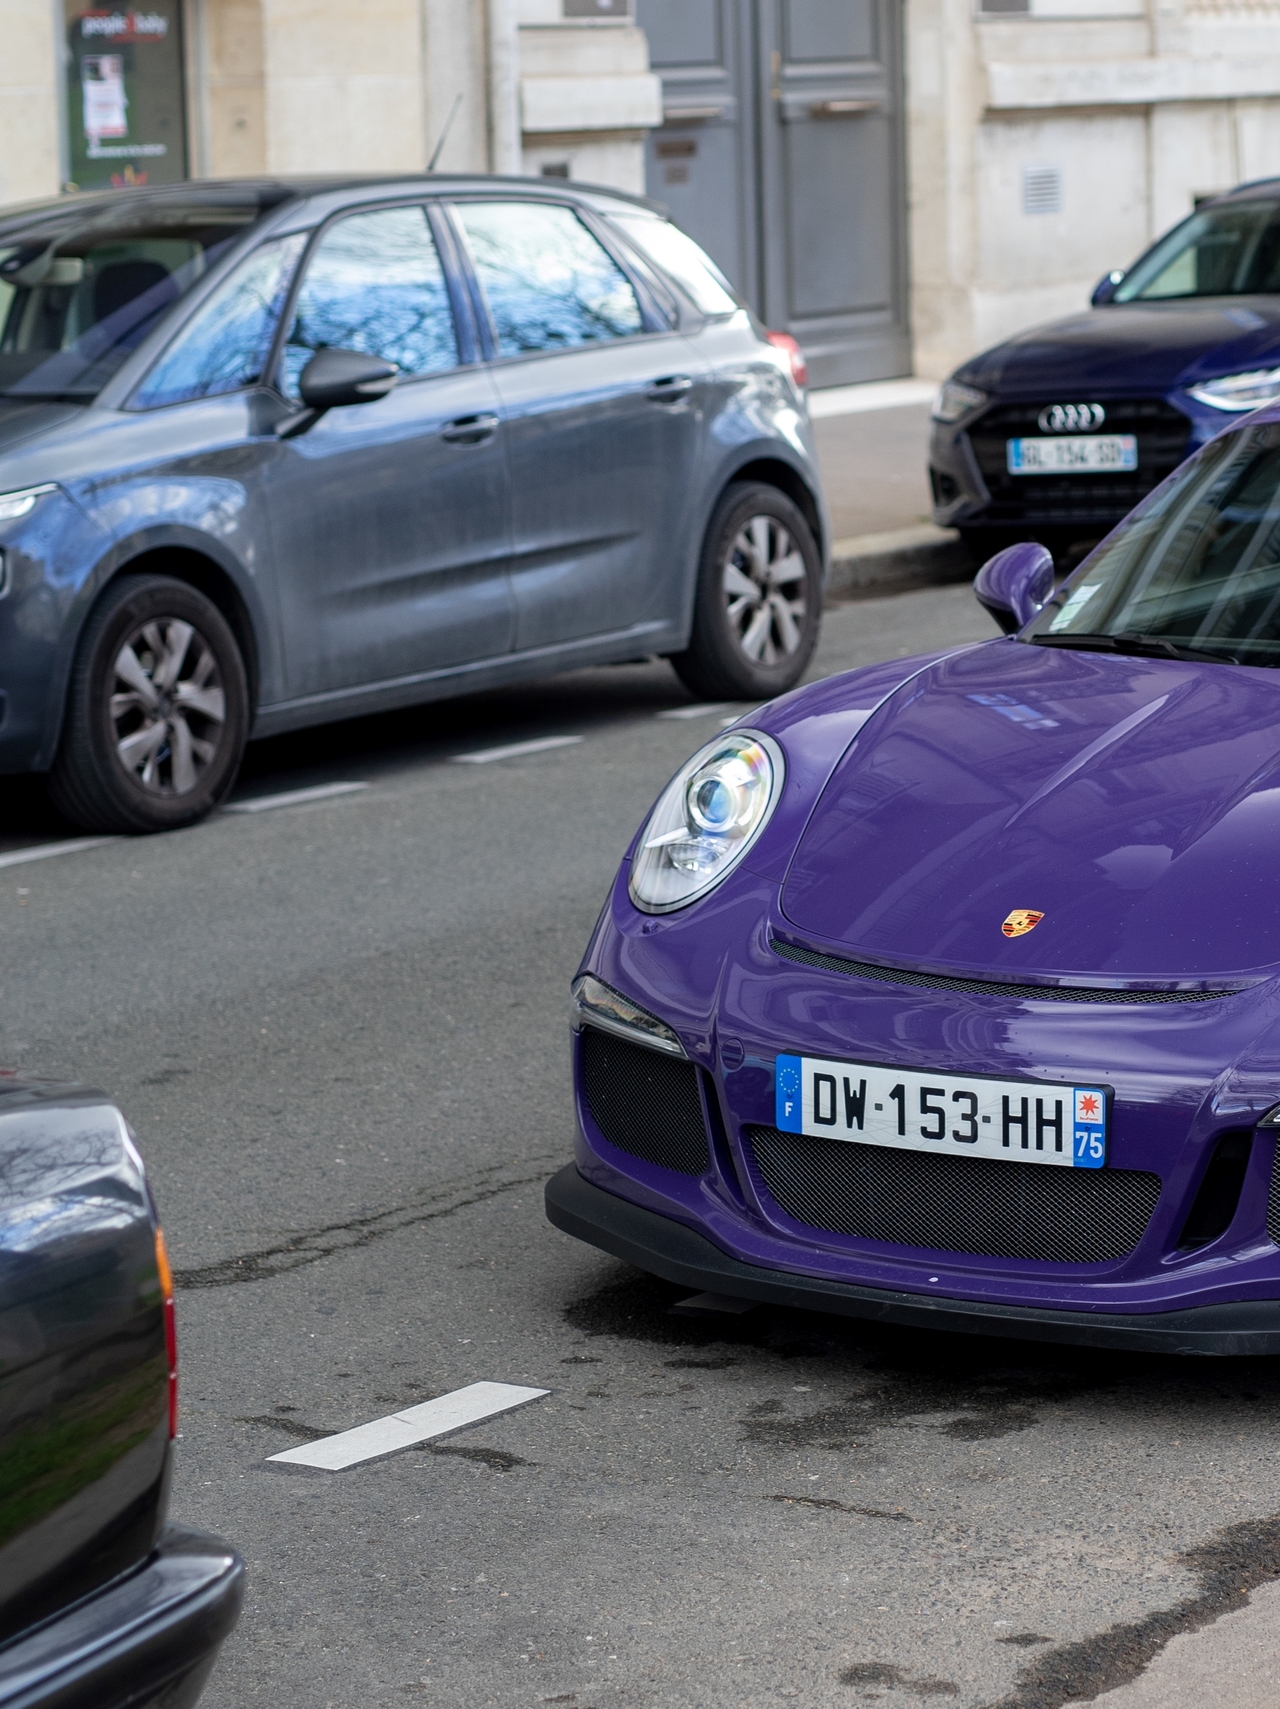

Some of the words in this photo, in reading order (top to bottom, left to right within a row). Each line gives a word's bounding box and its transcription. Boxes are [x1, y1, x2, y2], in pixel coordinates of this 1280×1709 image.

[785, 1102, 793, 1117] F
[813, 1072, 1063, 1152] DW-153-HH
[1075, 1131, 1103, 1158] 75
